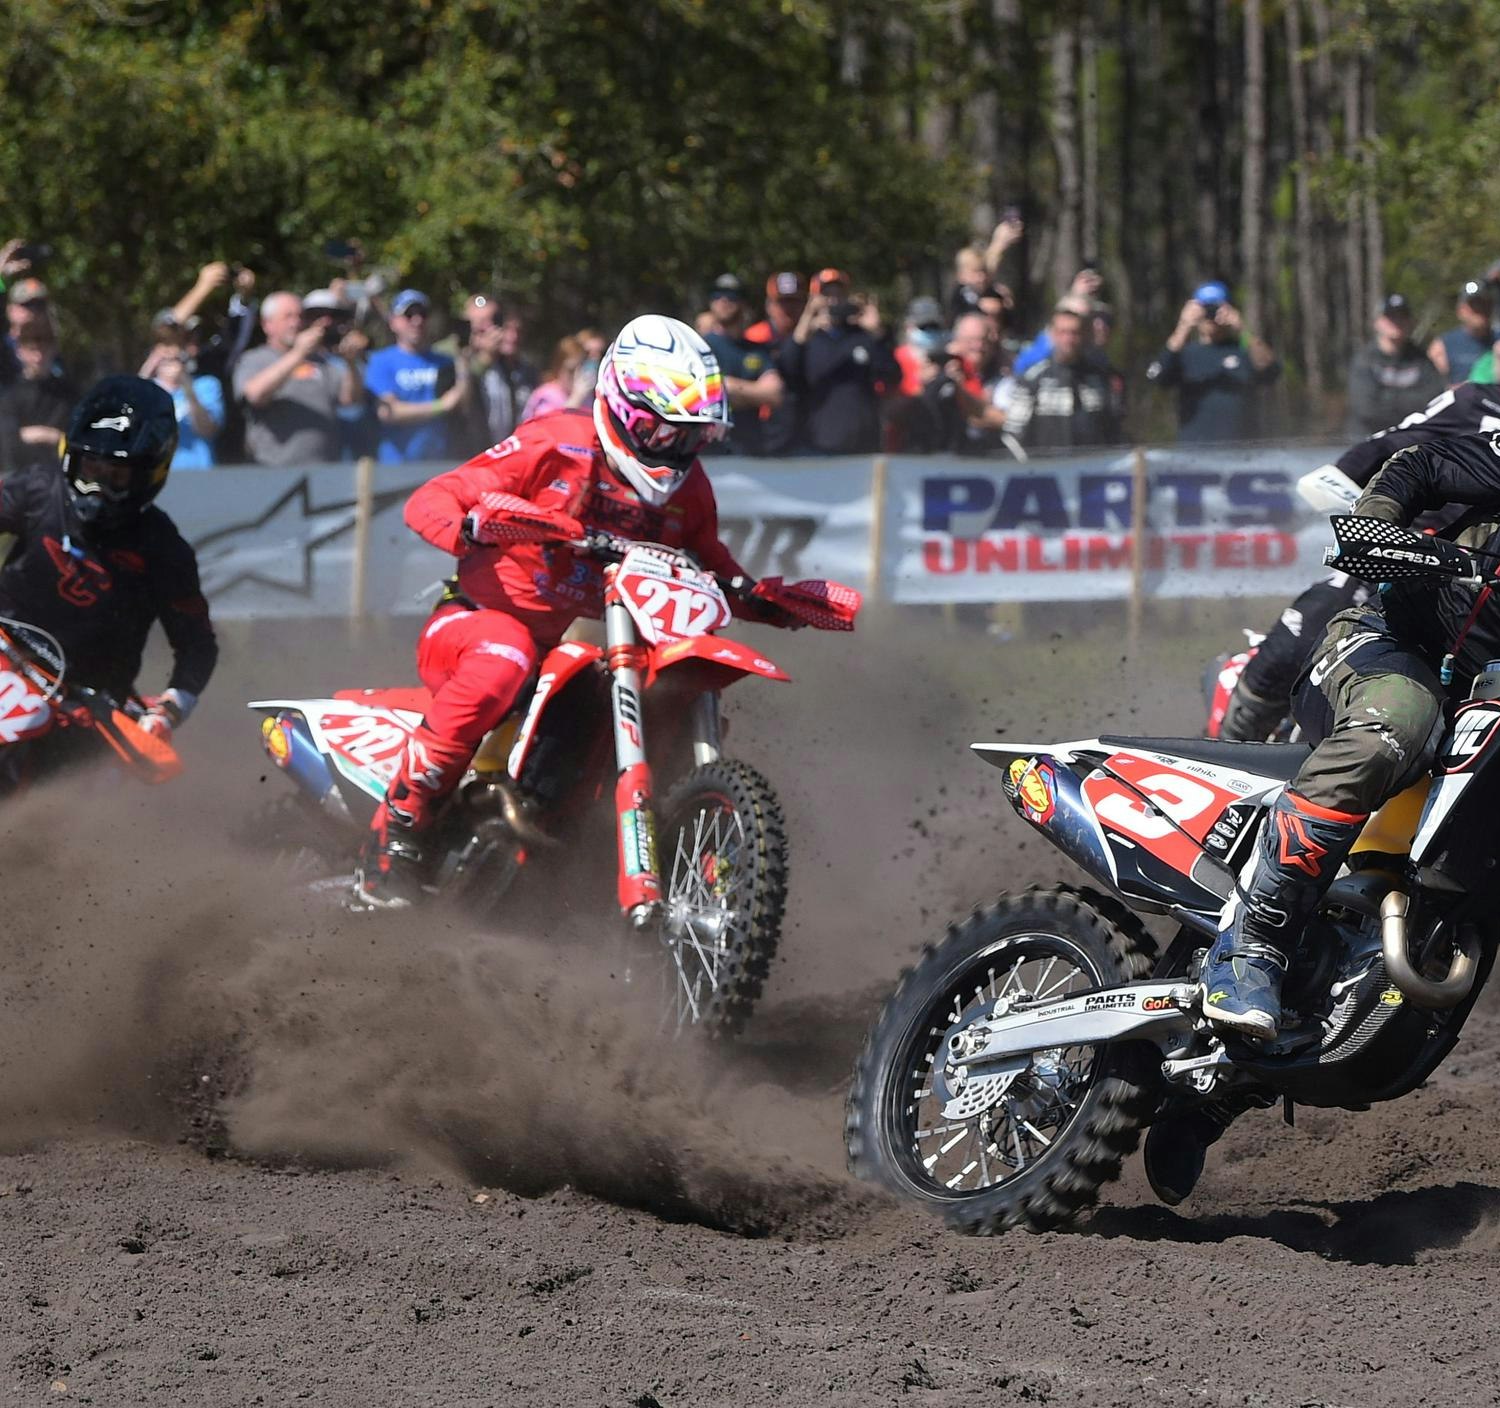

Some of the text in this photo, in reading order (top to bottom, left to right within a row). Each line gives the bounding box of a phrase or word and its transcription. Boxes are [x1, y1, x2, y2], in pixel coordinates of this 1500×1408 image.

[921, 472, 1297, 532] PARTS
[922, 531, 1297, 575] UNLIMITED
[1367, 546, 1441, 566] ACERBIS
[635, 577, 722, 637] 212
[1096, 773, 1216, 840] 3
[1084, 1001, 1136, 1012] UNLIMITED
[1085, 993, 1136, 1006] PARTS
